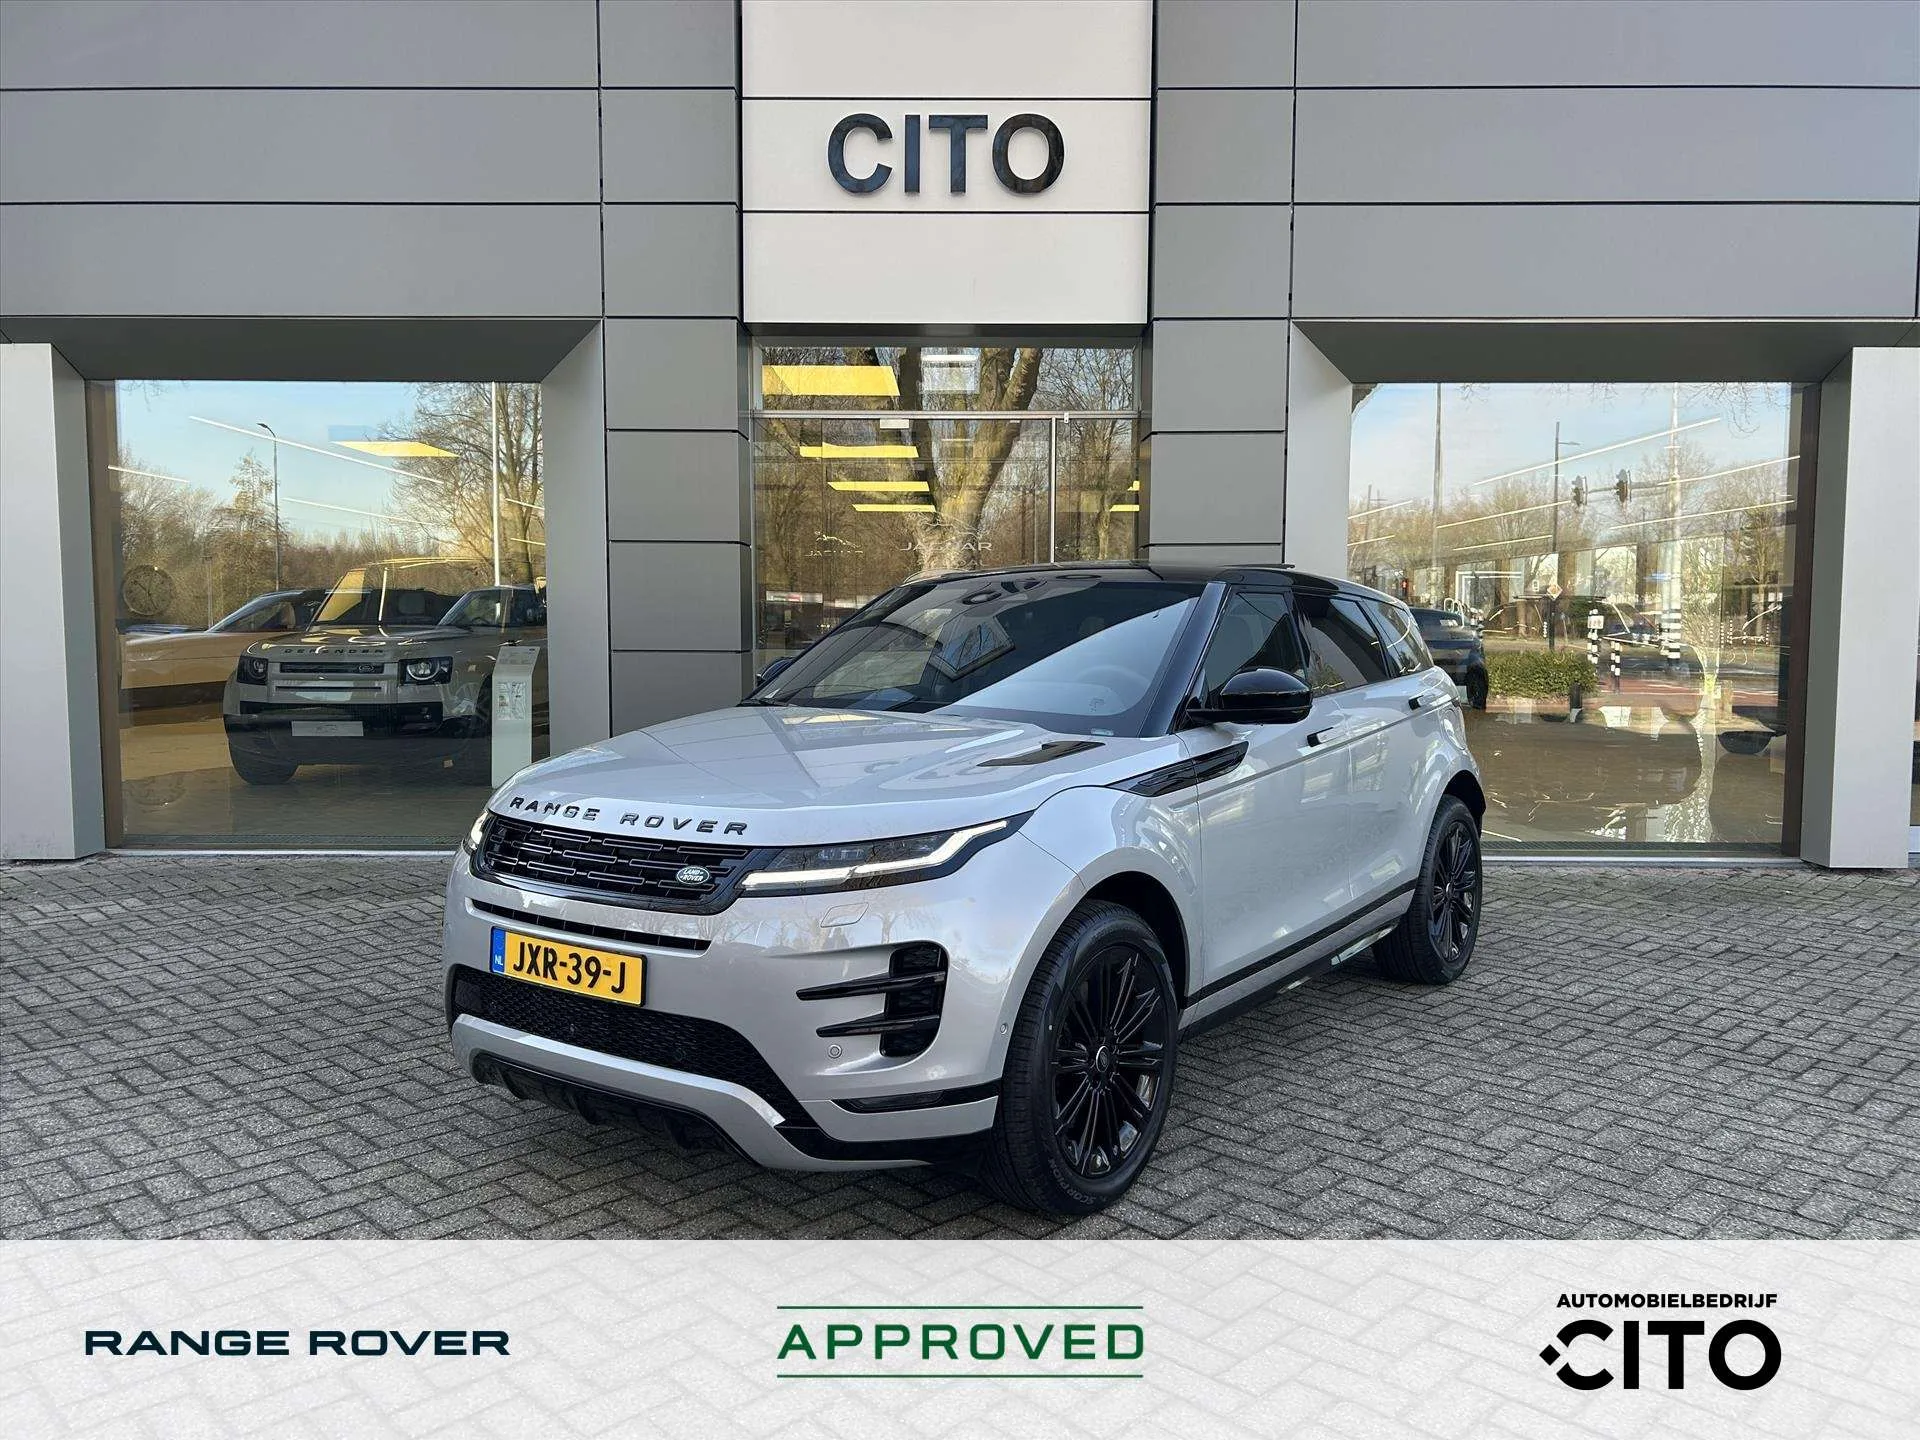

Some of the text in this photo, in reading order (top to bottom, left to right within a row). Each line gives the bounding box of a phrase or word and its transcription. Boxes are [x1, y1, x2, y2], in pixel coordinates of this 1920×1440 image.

[828, 114, 1065, 197] CITO
[509, 796, 748, 836] RANGE ROVER
[682, 874, 704, 882] ROVER
[494, 954, 504, 966] NL
[513, 941, 626, 994] JXR-39-J
